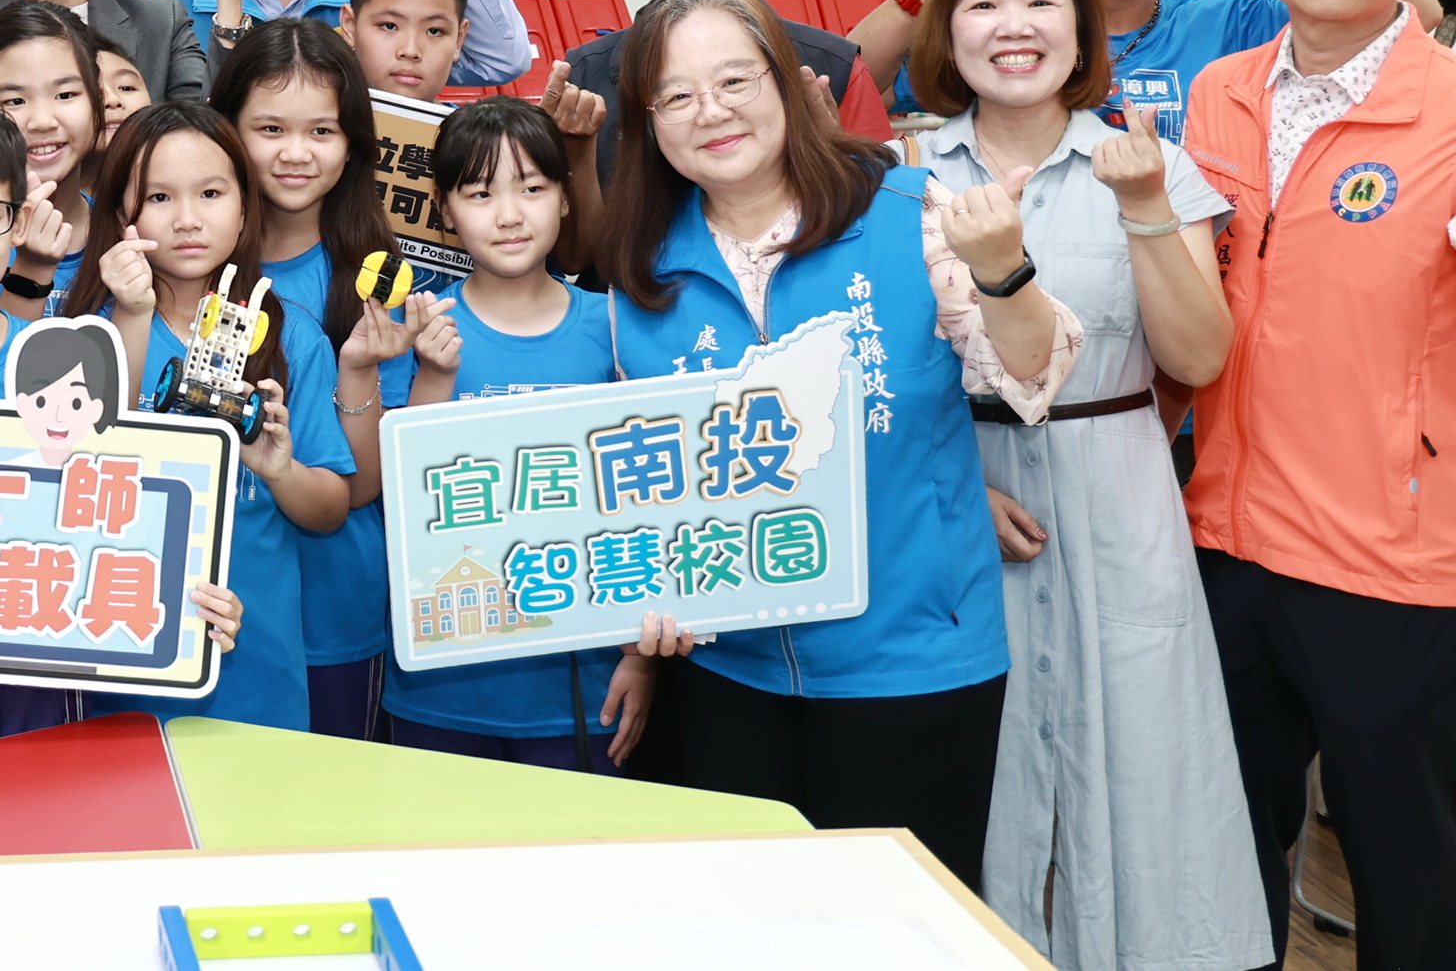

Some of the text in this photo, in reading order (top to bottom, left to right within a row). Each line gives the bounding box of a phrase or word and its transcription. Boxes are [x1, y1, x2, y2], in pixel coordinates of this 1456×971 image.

[1122, 78, 1169, 96] 漳興
[846, 271, 896, 435] 南投縣政府
[427, 390, 801, 533] 宜居南投
[507, 510, 829, 614] 智慧校園
